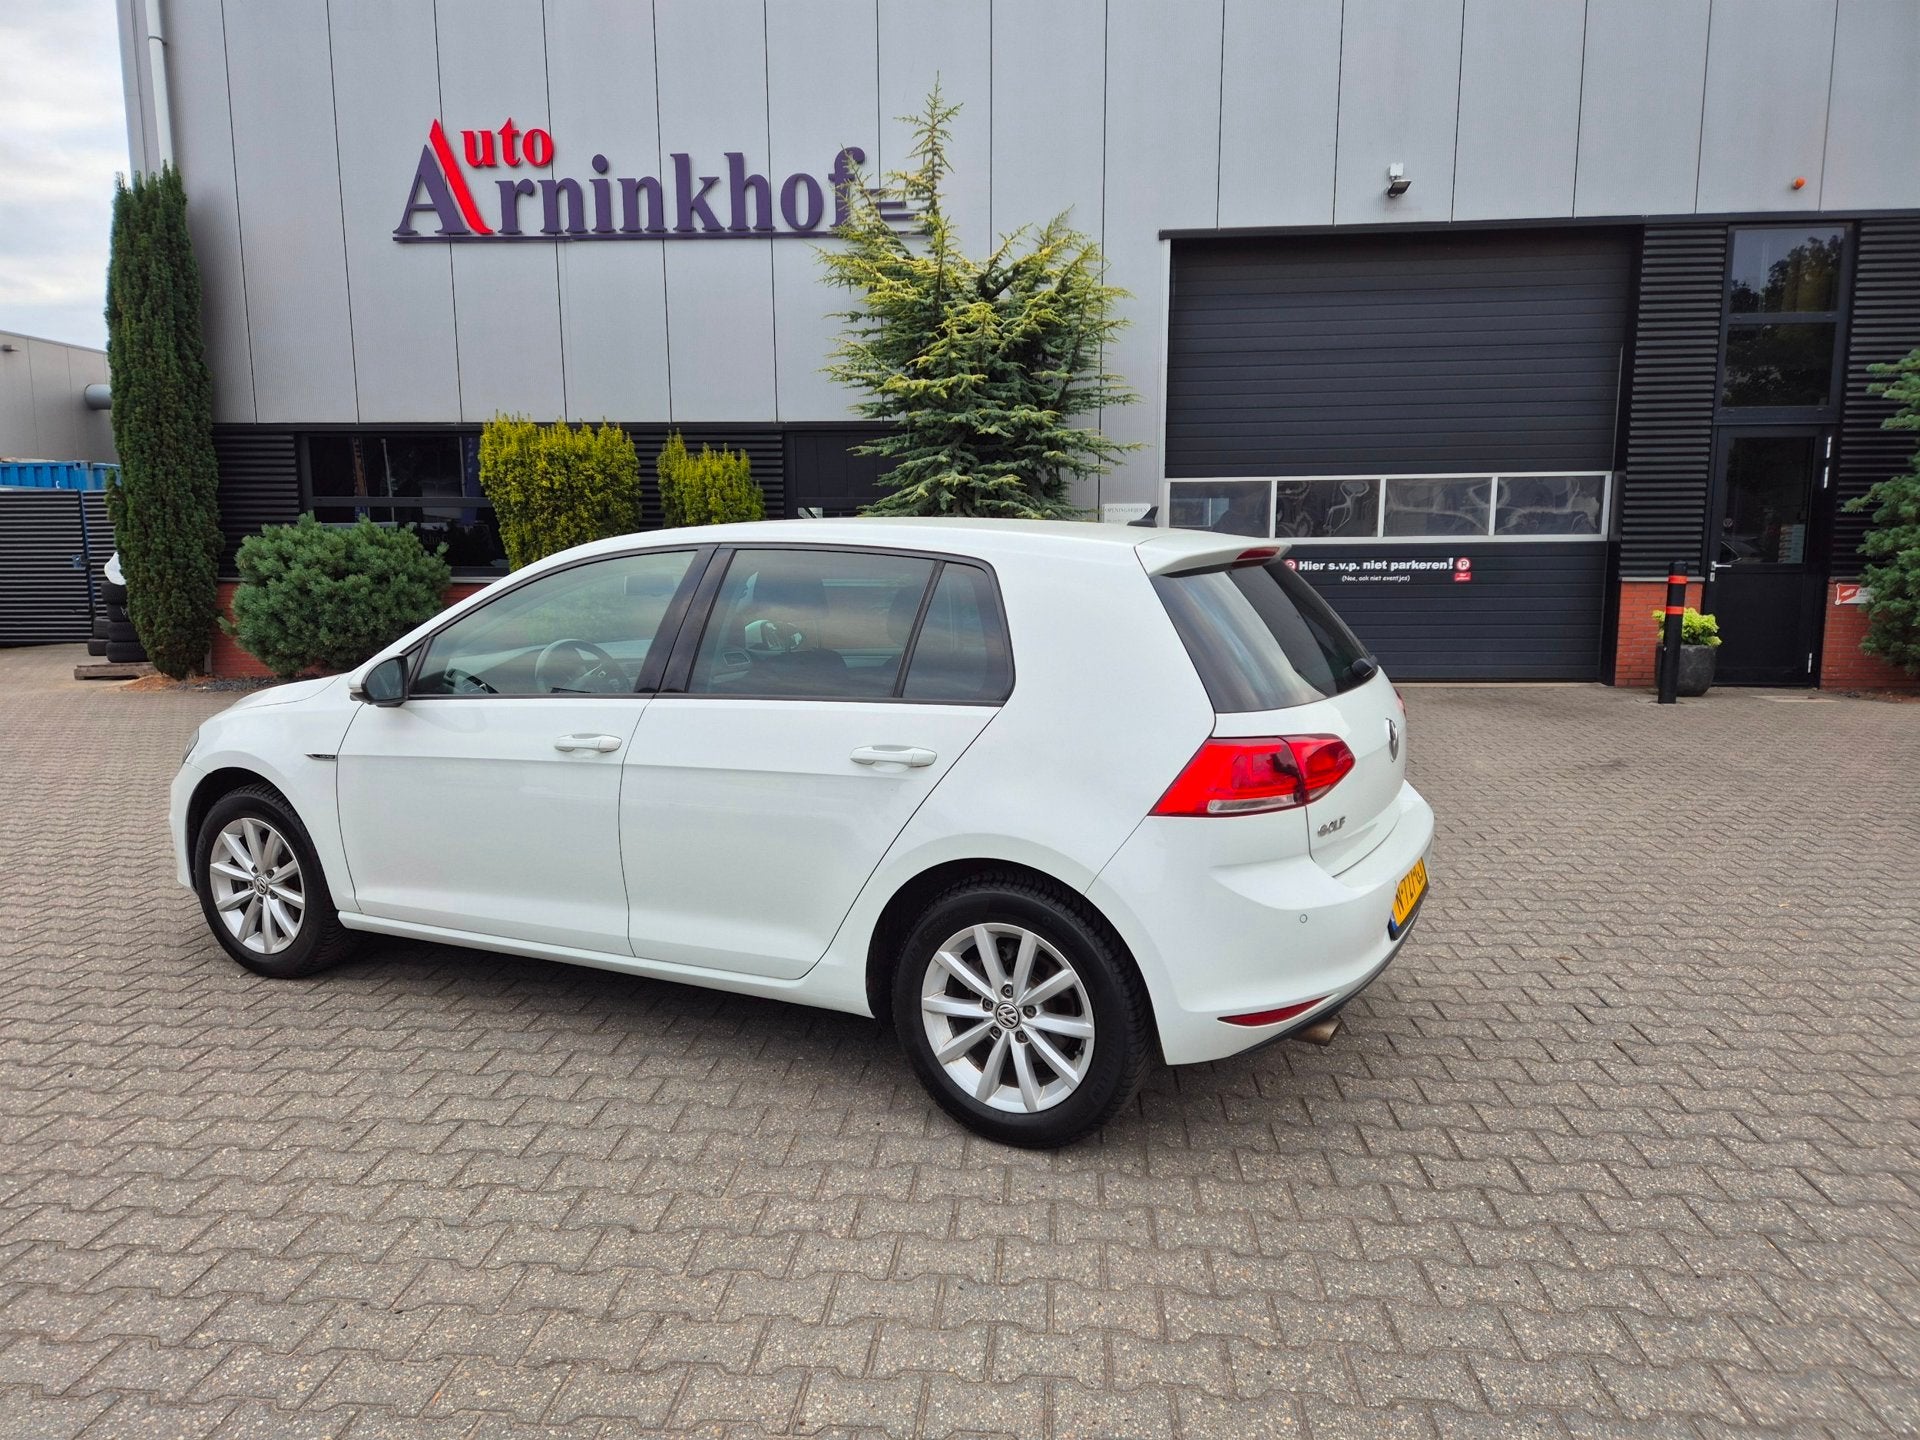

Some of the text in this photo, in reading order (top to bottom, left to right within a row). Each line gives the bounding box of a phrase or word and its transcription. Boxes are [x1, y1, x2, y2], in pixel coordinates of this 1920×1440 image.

[392, 144, 866, 235] Arninkhof
[1299, 561, 1325, 570] Hier
[1328, 562, 1360, 572] s.v.p.
[1363, 560, 1388, 569] niet
[1390, 557, 1454, 572] parkeren!
